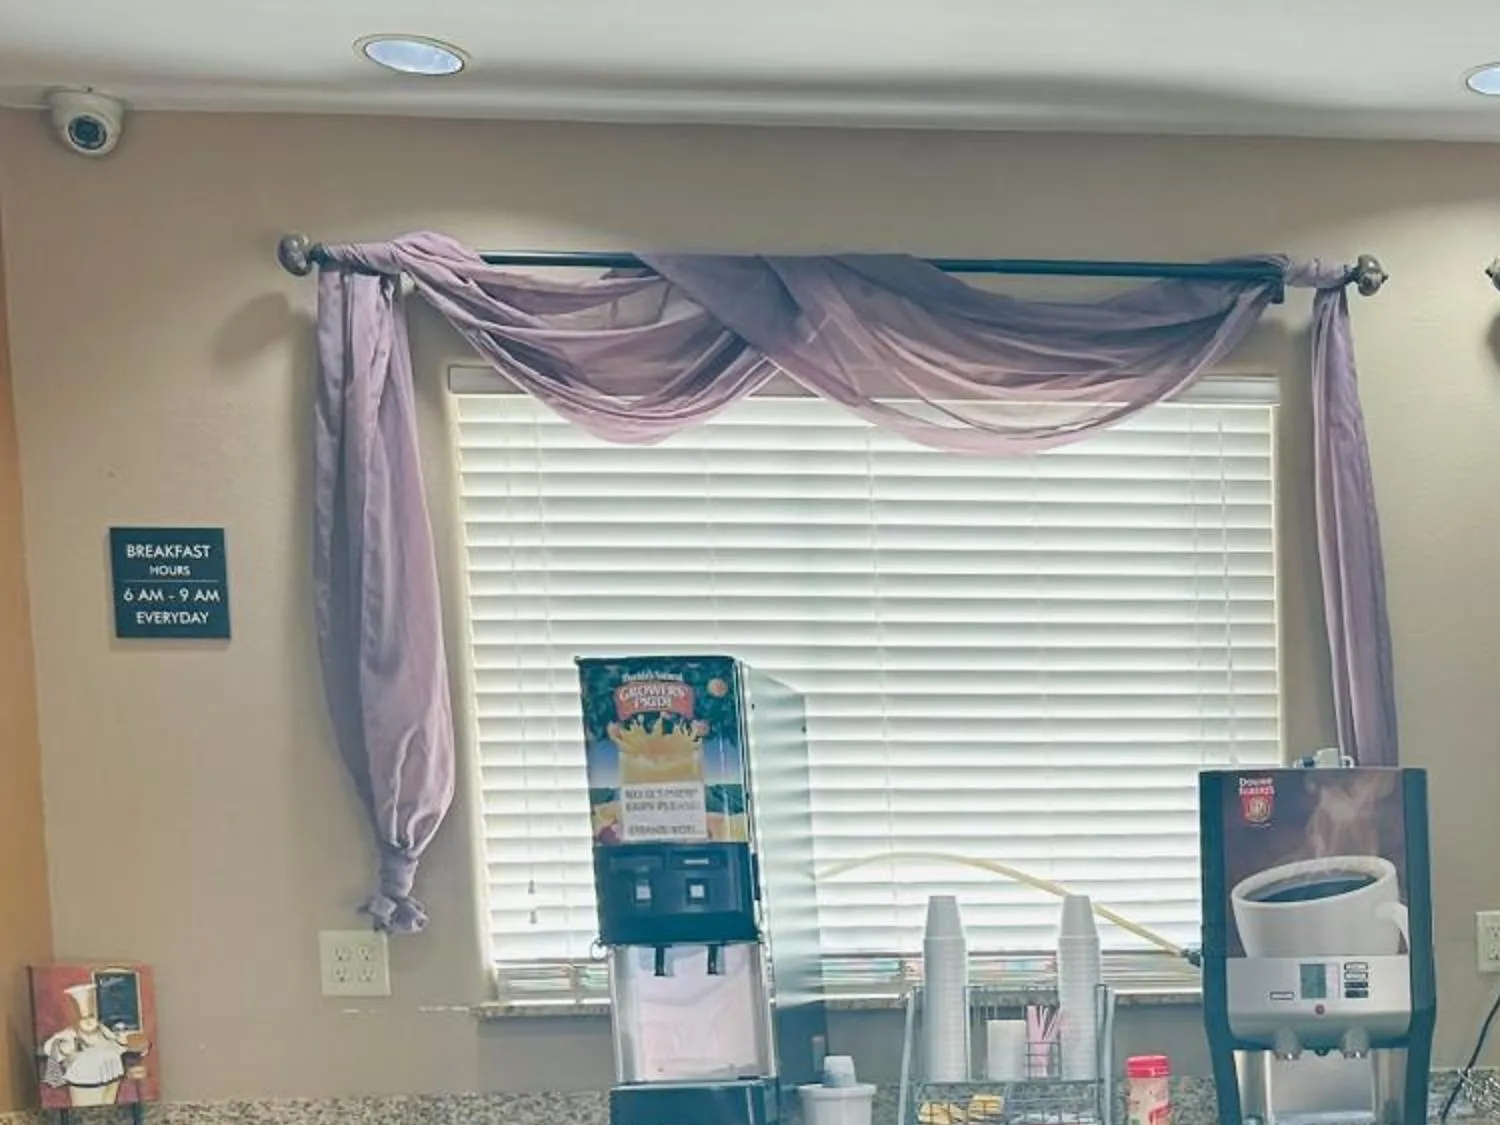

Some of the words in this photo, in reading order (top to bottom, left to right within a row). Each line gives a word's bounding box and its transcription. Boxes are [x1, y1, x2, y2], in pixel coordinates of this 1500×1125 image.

[126, 544, 211, 559] BREAKFAST
[149, 565, 191, 576] HOURS
[123, 588, 133, 601] 6
[138, 589, 164, 601] AM
[179, 587, 189, 602] 9
[194, 589, 220, 601] AM
[136, 611, 209, 625] EVERYDAY
